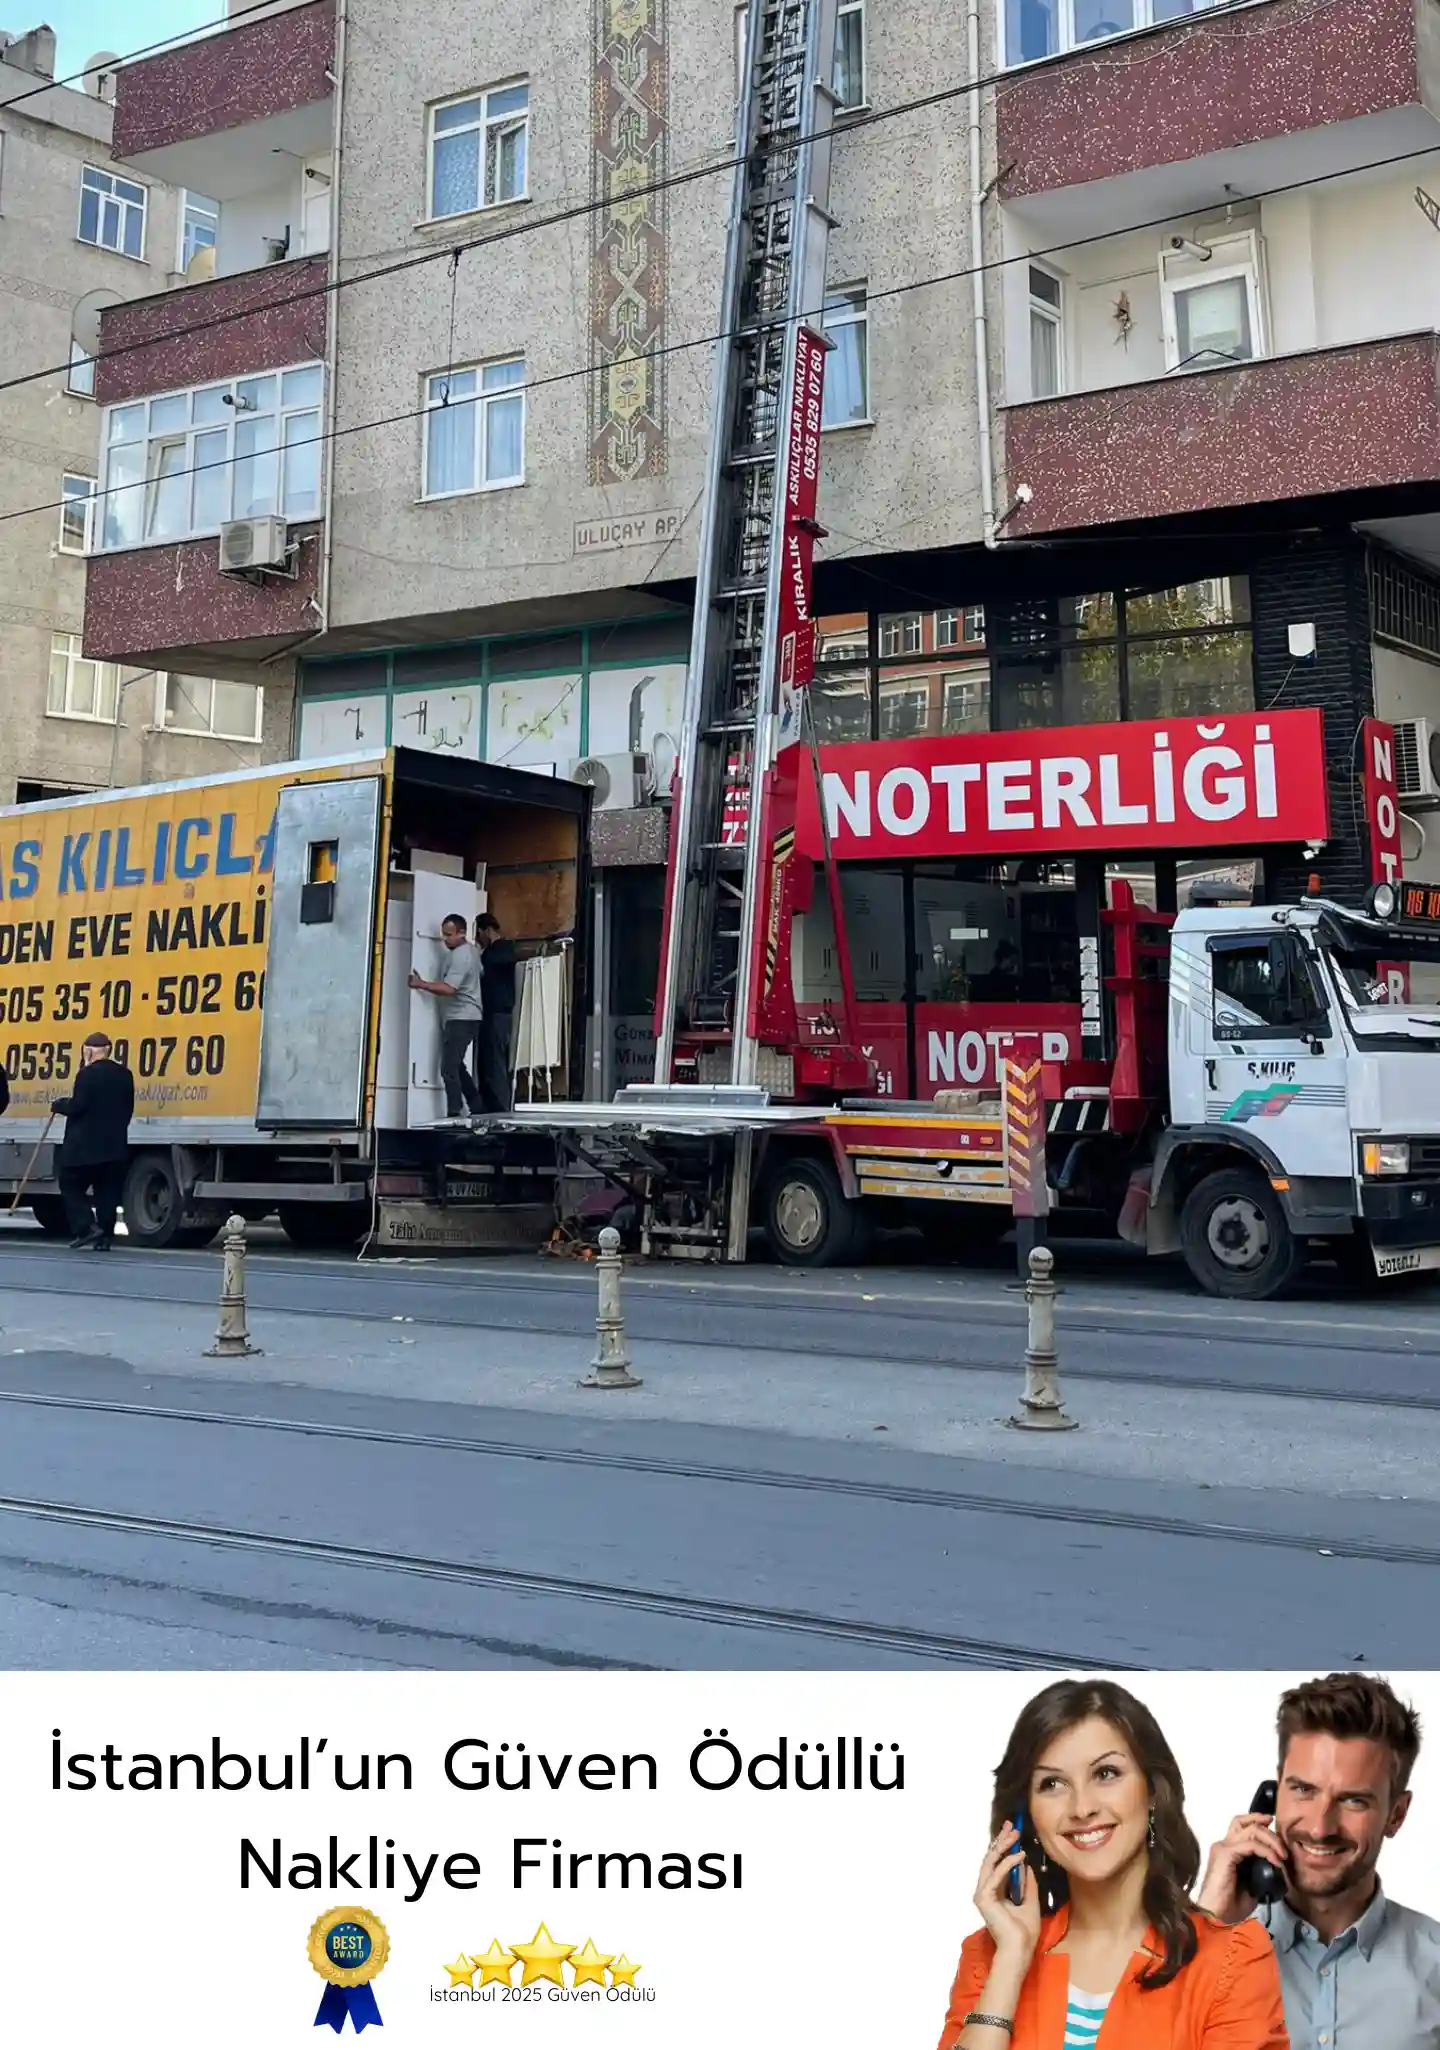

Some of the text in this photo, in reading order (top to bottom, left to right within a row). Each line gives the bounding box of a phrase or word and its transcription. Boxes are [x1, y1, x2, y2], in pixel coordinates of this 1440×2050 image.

[806, 399, 820, 433] 829
[803, 434, 818, 480] 0535
[788, 535, 809, 621] KİRALIK
[823, 722, 1278, 838] NOTERLİĞİ
[0, 839, 43, 899] S
[68, 912, 132, 959] EVE
[146, 884, 266, 953] NAKLİ
[53, 982, 91, 1021] 35
[100, 980, 132, 1019] 10
[156, 973, 222, 1015] 502
[6, 1042, 73, 1080] 0535
[139, 1036, 177, 1077] 07
[186, 1034, 226, 1076] 60
[927, 1030, 1069, 1083] NOTR
